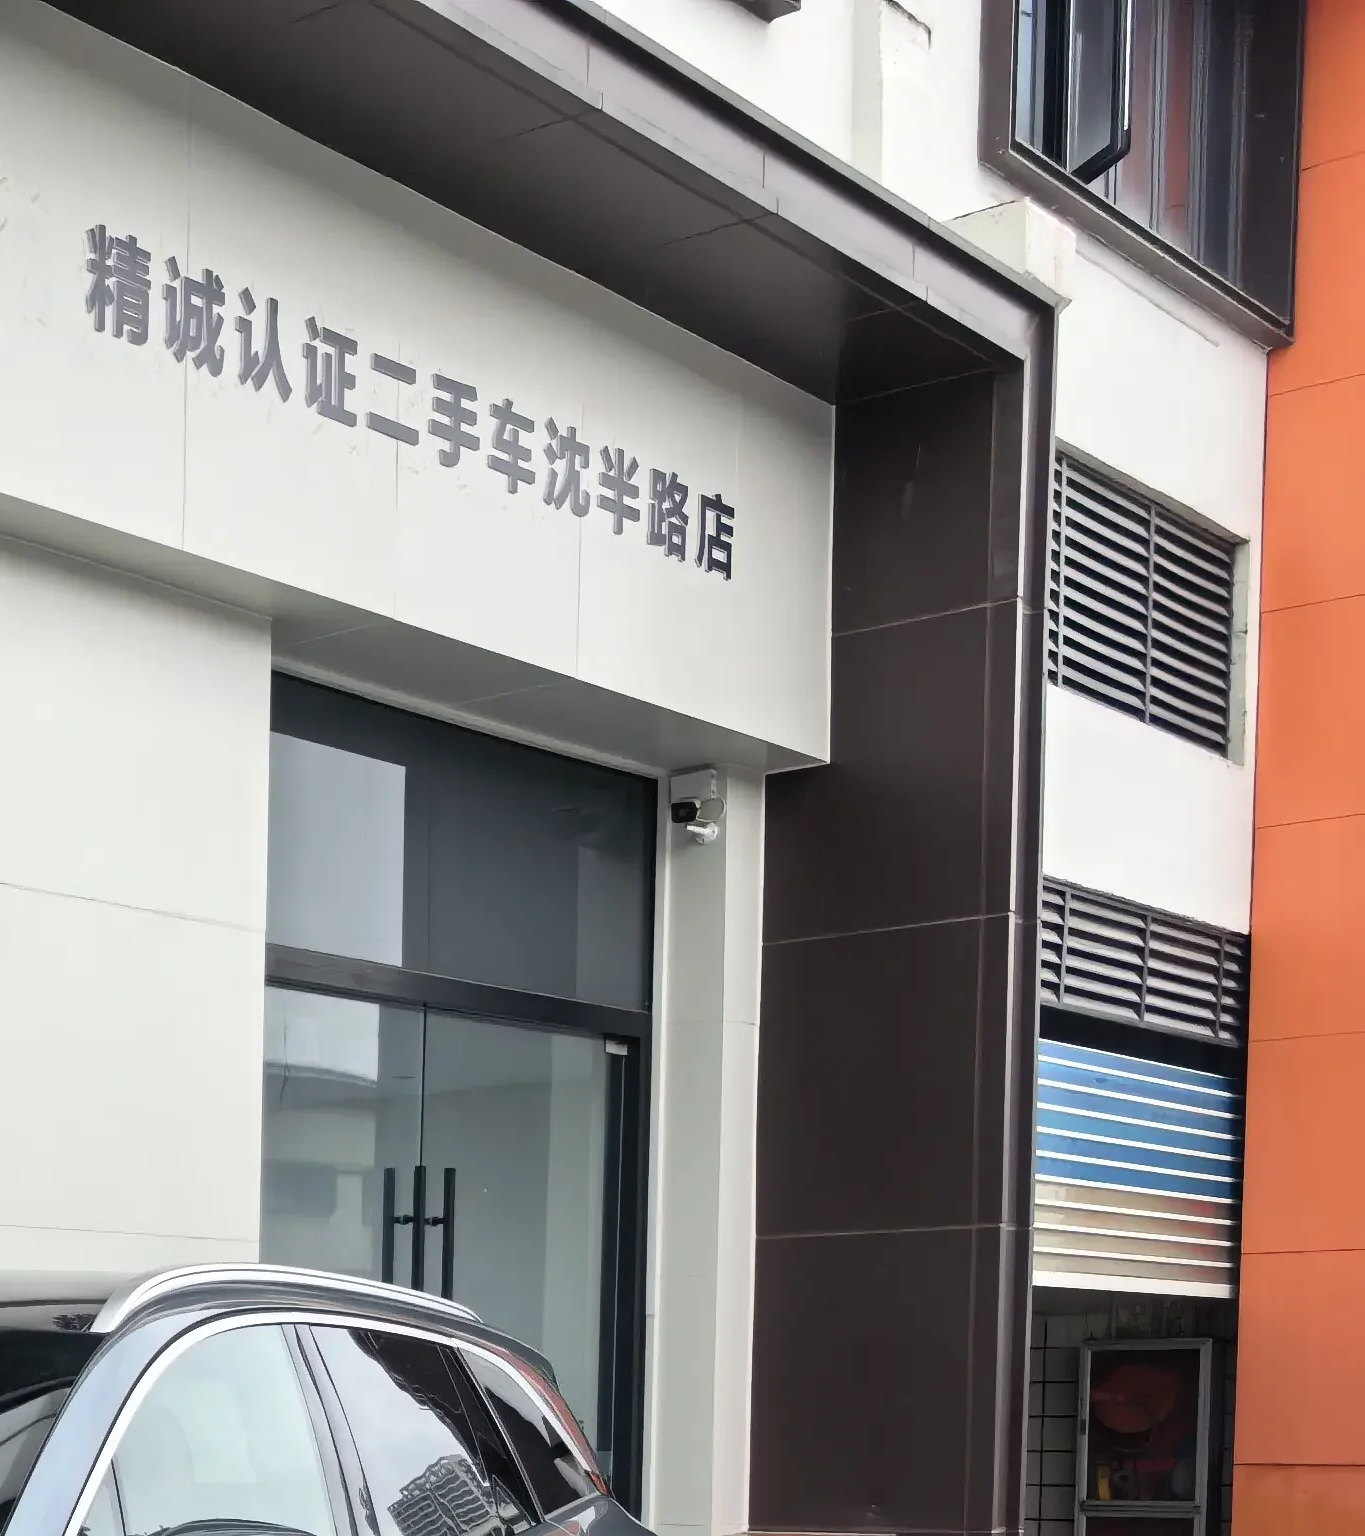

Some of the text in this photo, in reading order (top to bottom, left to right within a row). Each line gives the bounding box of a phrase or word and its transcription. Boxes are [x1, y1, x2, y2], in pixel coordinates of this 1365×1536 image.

[84, 224, 737, 581] 精诚认证二手车沈半路店
